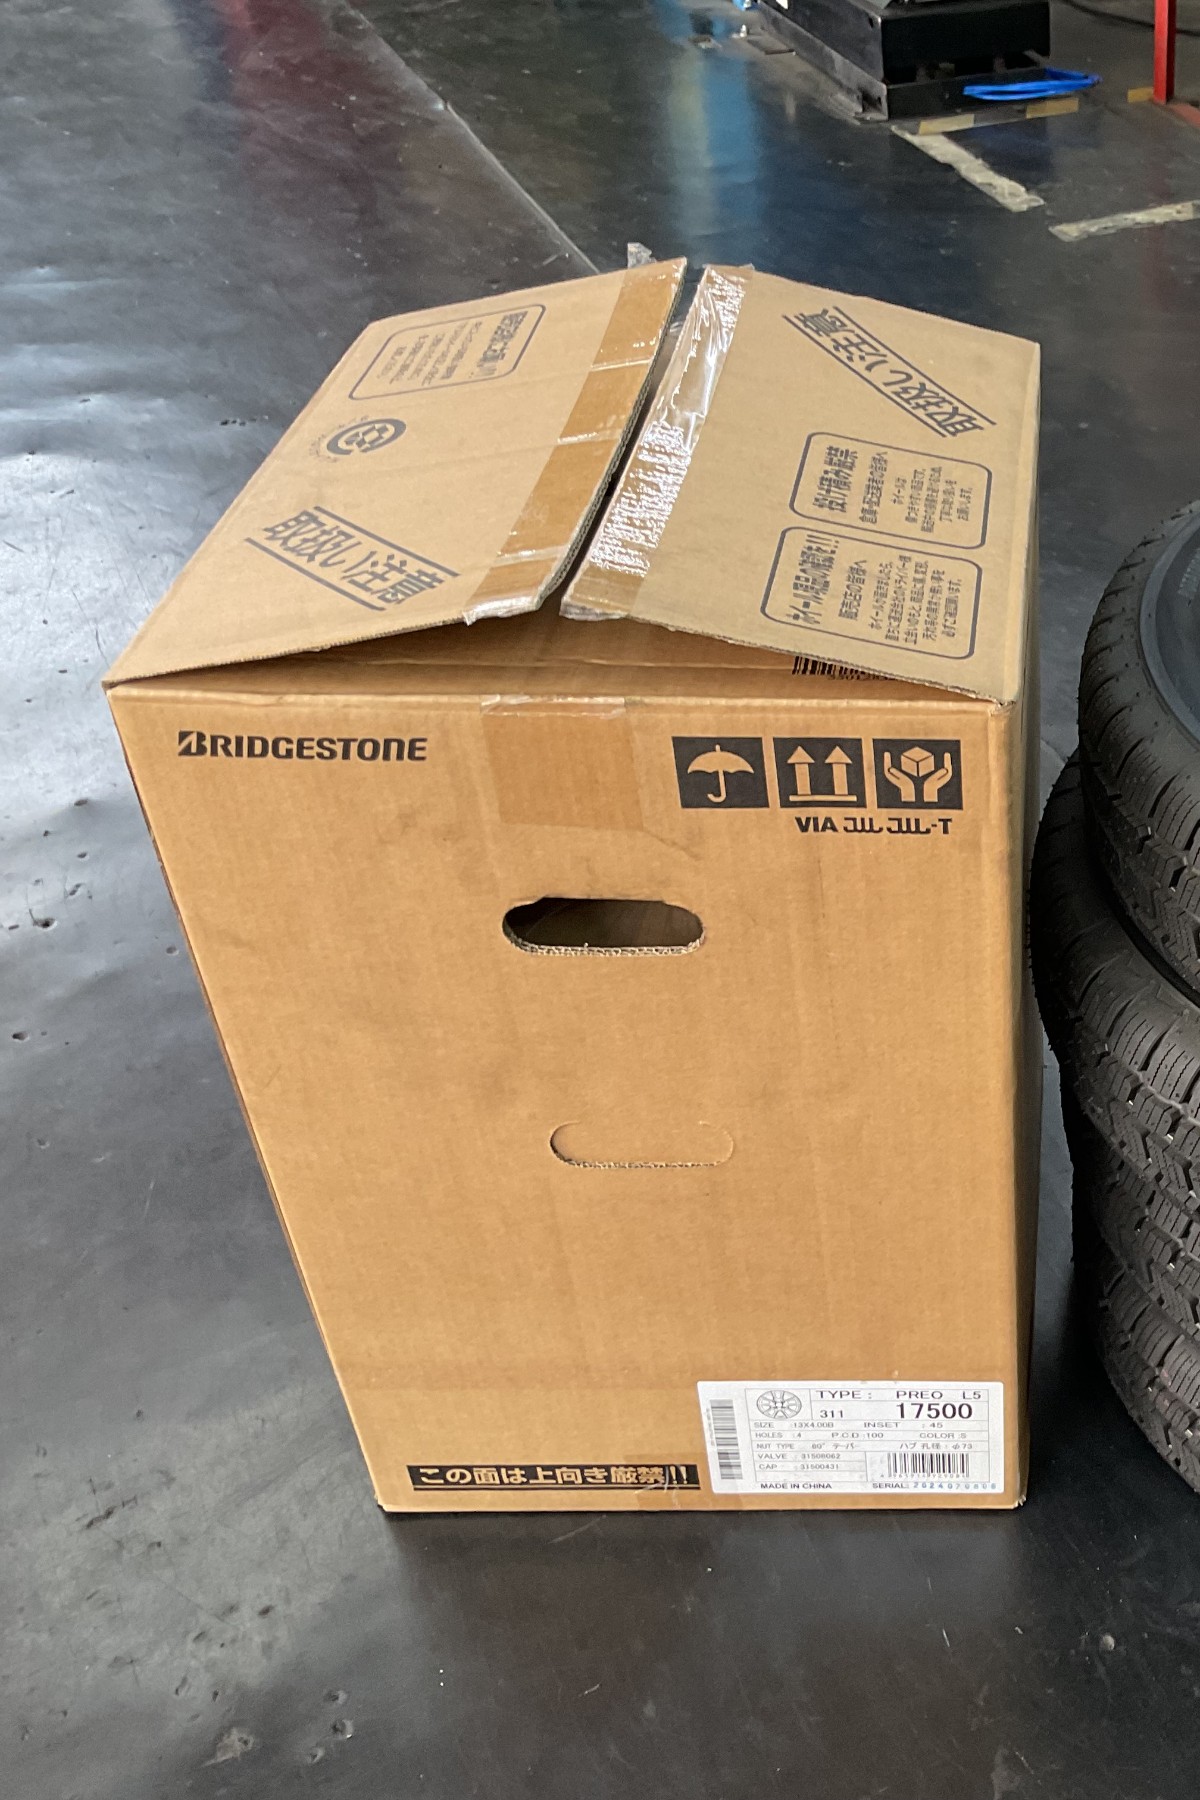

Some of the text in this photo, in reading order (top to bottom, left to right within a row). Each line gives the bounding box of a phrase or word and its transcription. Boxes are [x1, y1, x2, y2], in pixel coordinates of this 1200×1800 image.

[794, 308, 985, 437] 取扱い注意
[262, 509, 445, 604] 取扱い注意
[178, 730, 427, 761] BRIDGESTONE
[795, 816, 839, 833] VIA
[896, 1390, 943, 1399] PREO
[962, 1390, 981, 1399] L5
[820, 1402, 973, 1419] 311 17500
